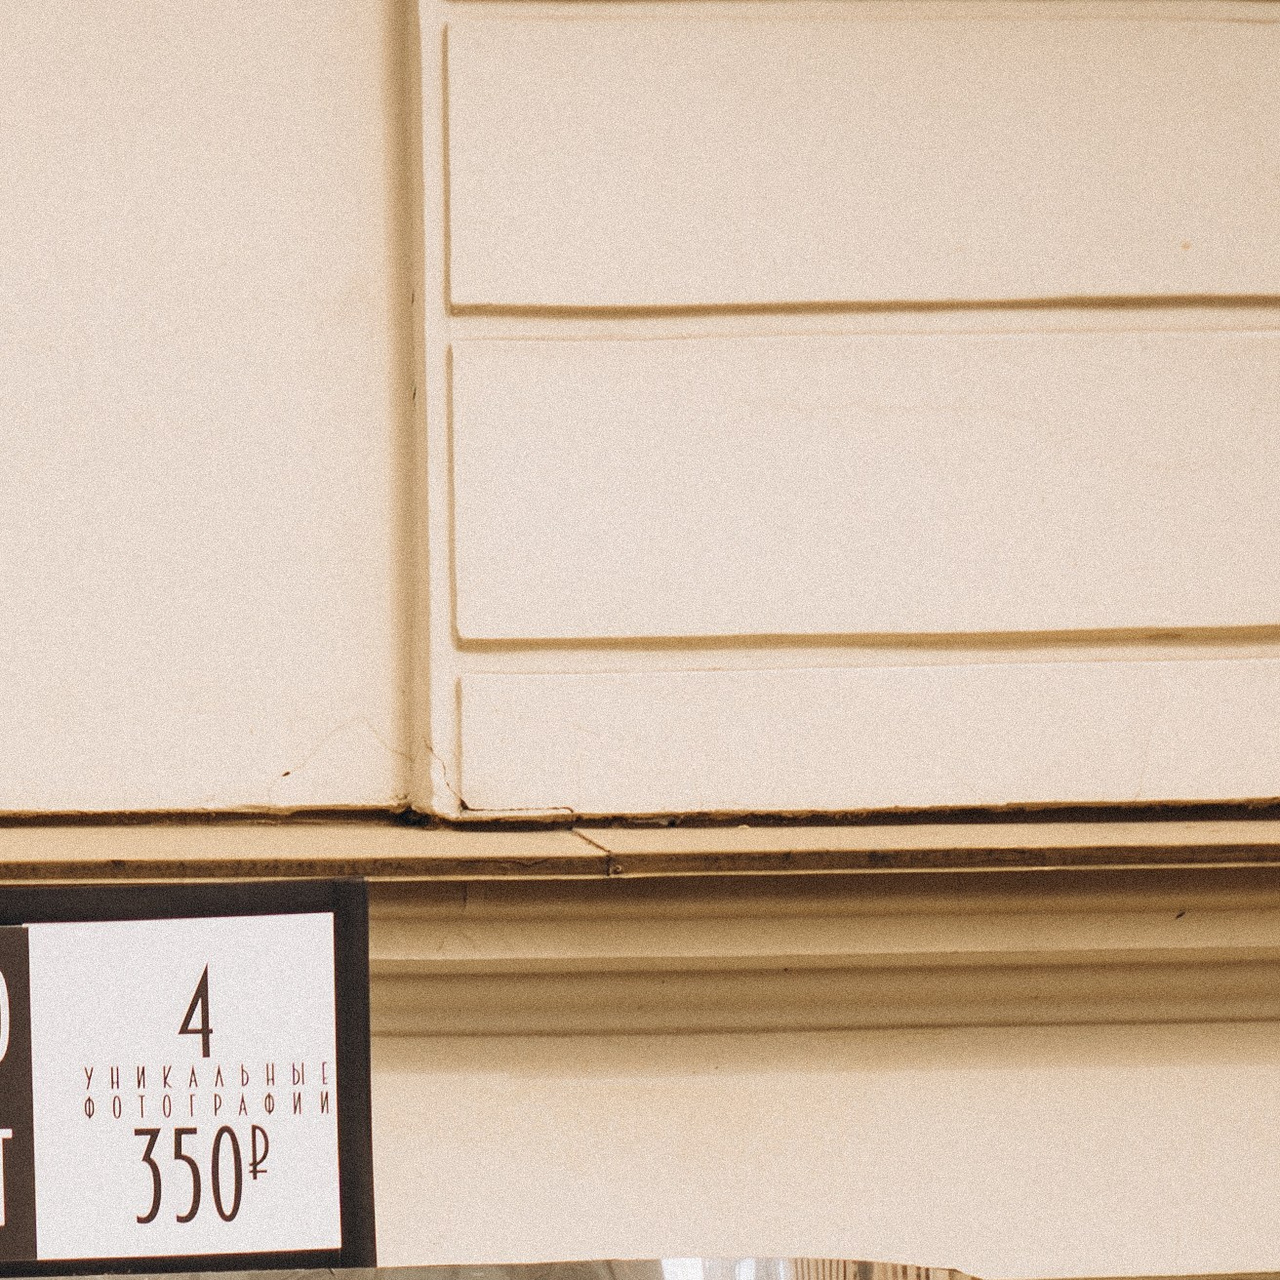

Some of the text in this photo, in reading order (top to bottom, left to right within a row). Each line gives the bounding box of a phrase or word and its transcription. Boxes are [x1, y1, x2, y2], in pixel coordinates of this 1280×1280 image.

[179, 962, 214, 1058] 4
[84, 1061, 329, 1090] УНИКАЛЬНЫЕ
[84, 1091, 330, 1119] ФОТОГРАФИИ
